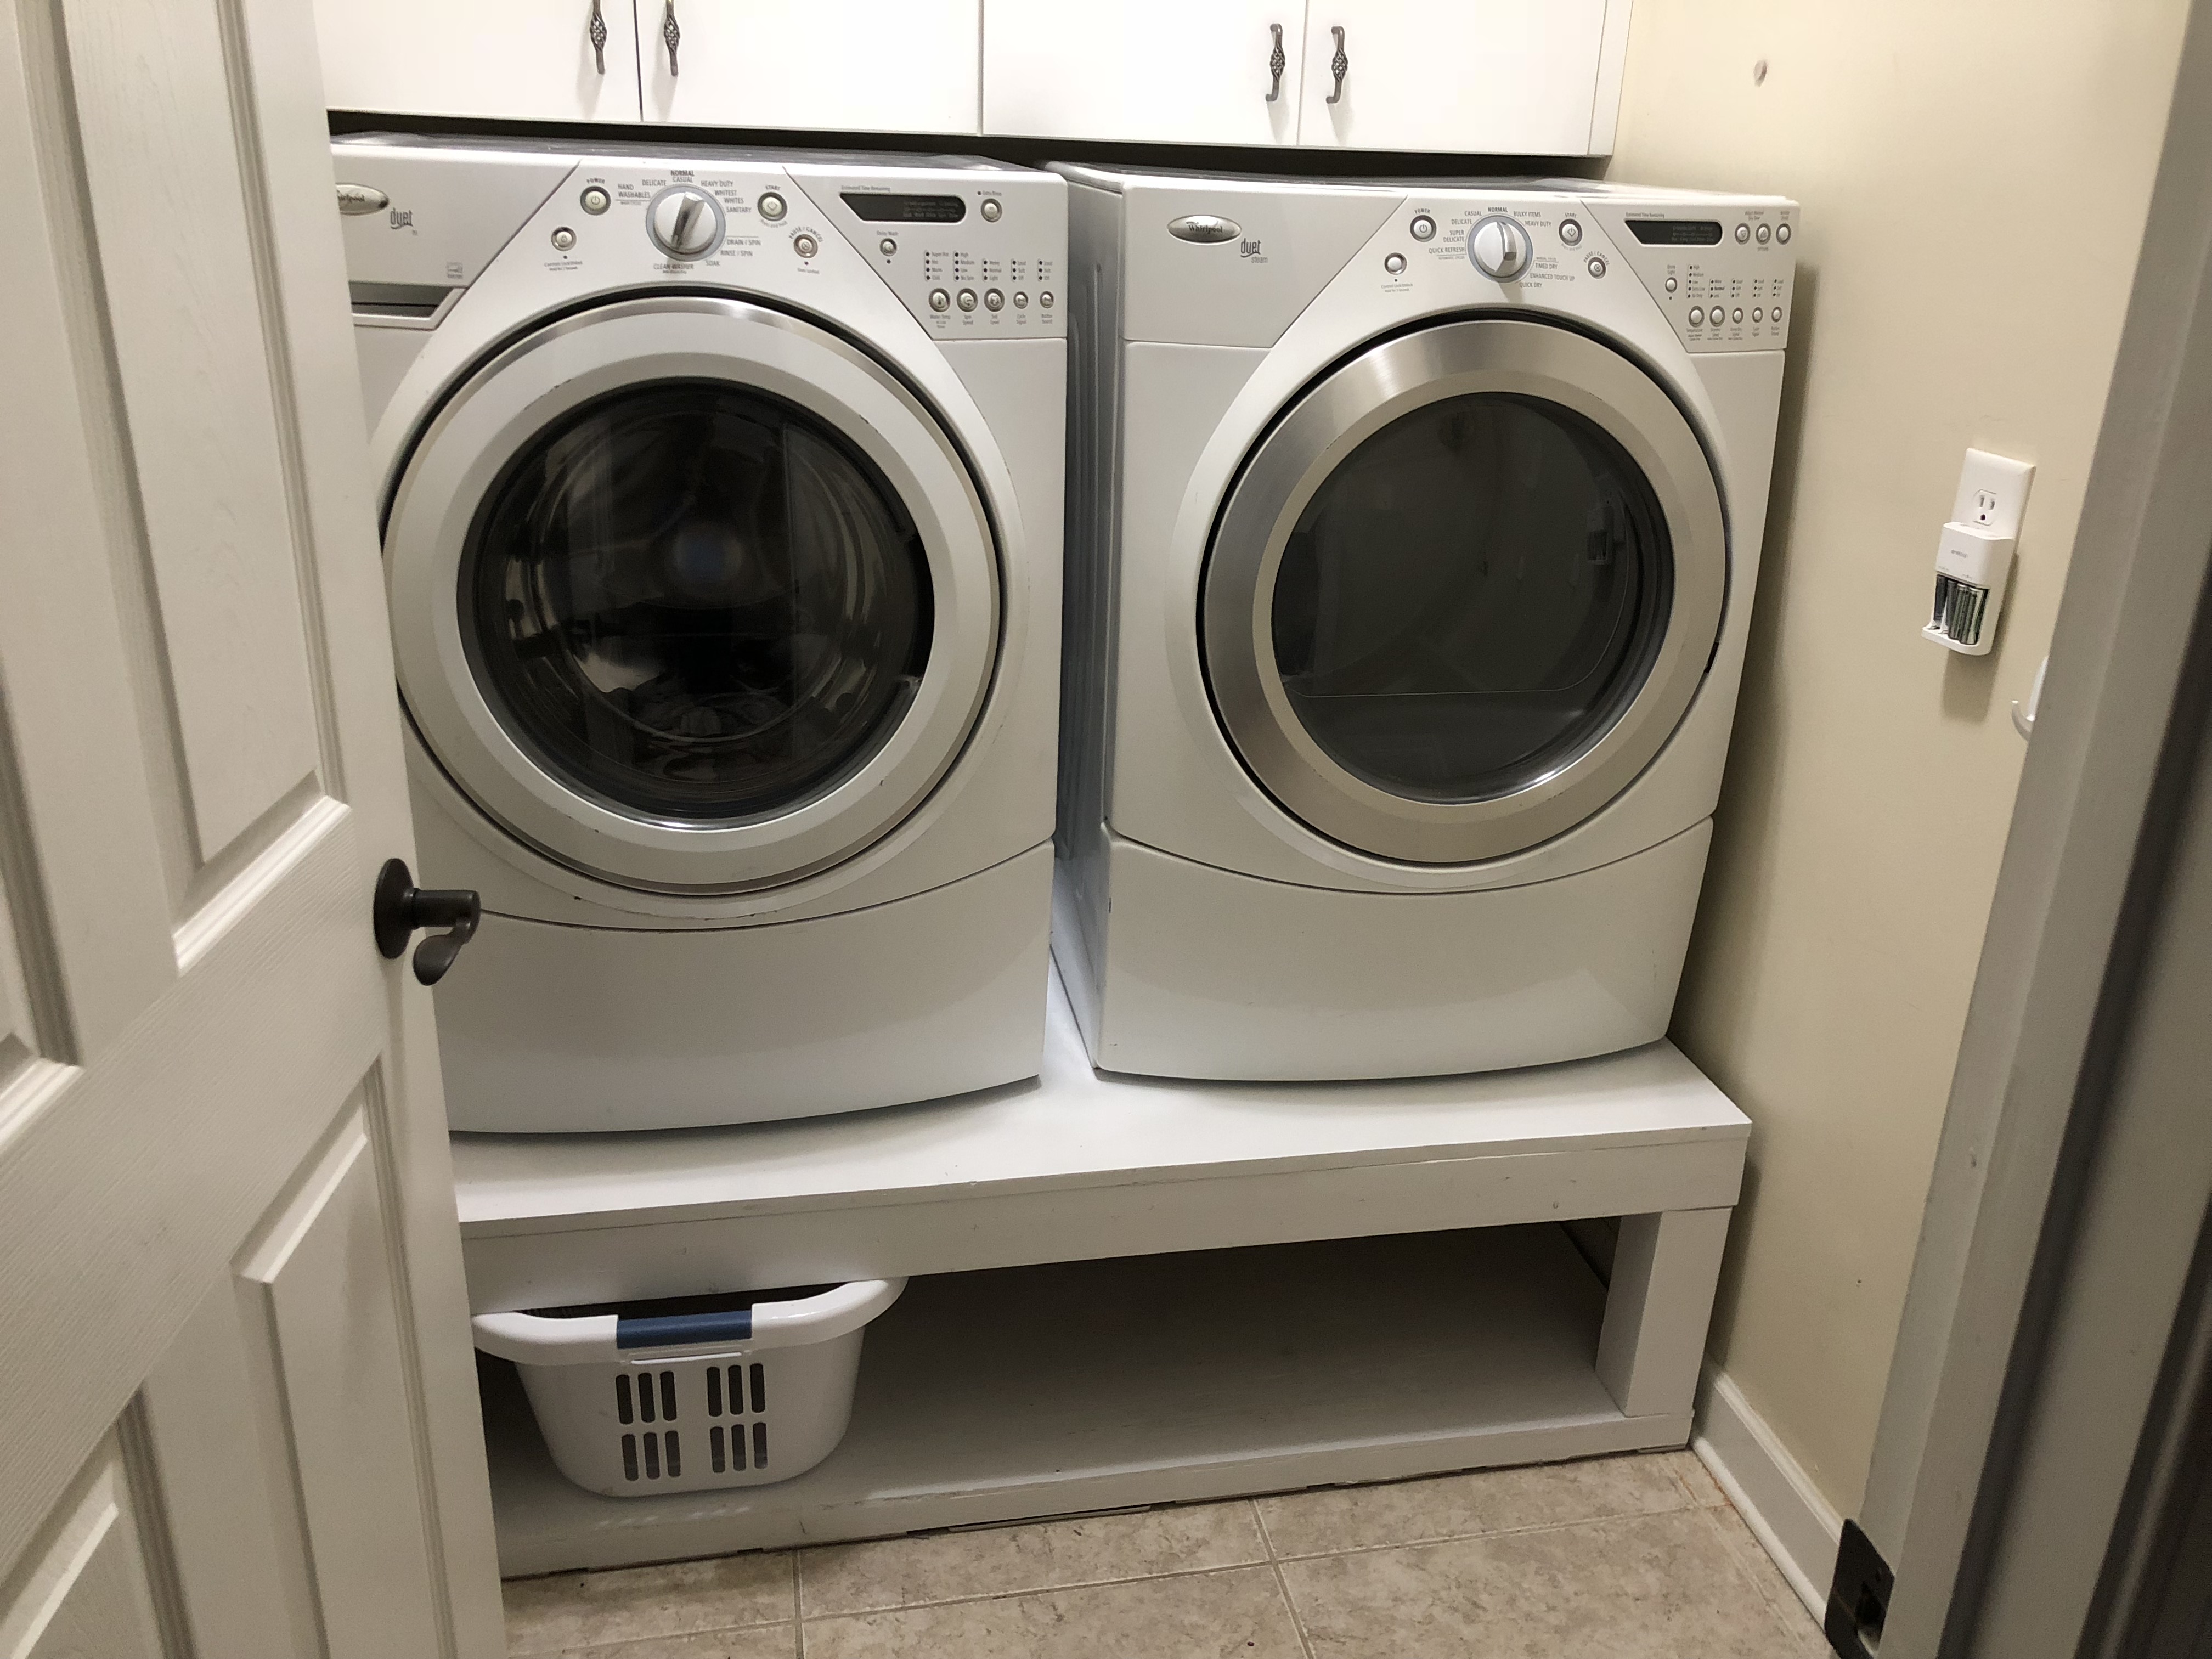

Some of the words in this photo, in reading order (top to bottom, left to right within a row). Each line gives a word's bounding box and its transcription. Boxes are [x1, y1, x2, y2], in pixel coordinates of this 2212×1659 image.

[390, 207, 414, 229] duet
[1188, 224, 1223, 234] Whirlpool
[1240, 238, 1261, 258] duet
[1583, 251, 1593, 263] PAUSE
[1596, 251, 1610, 266] CANCEL
